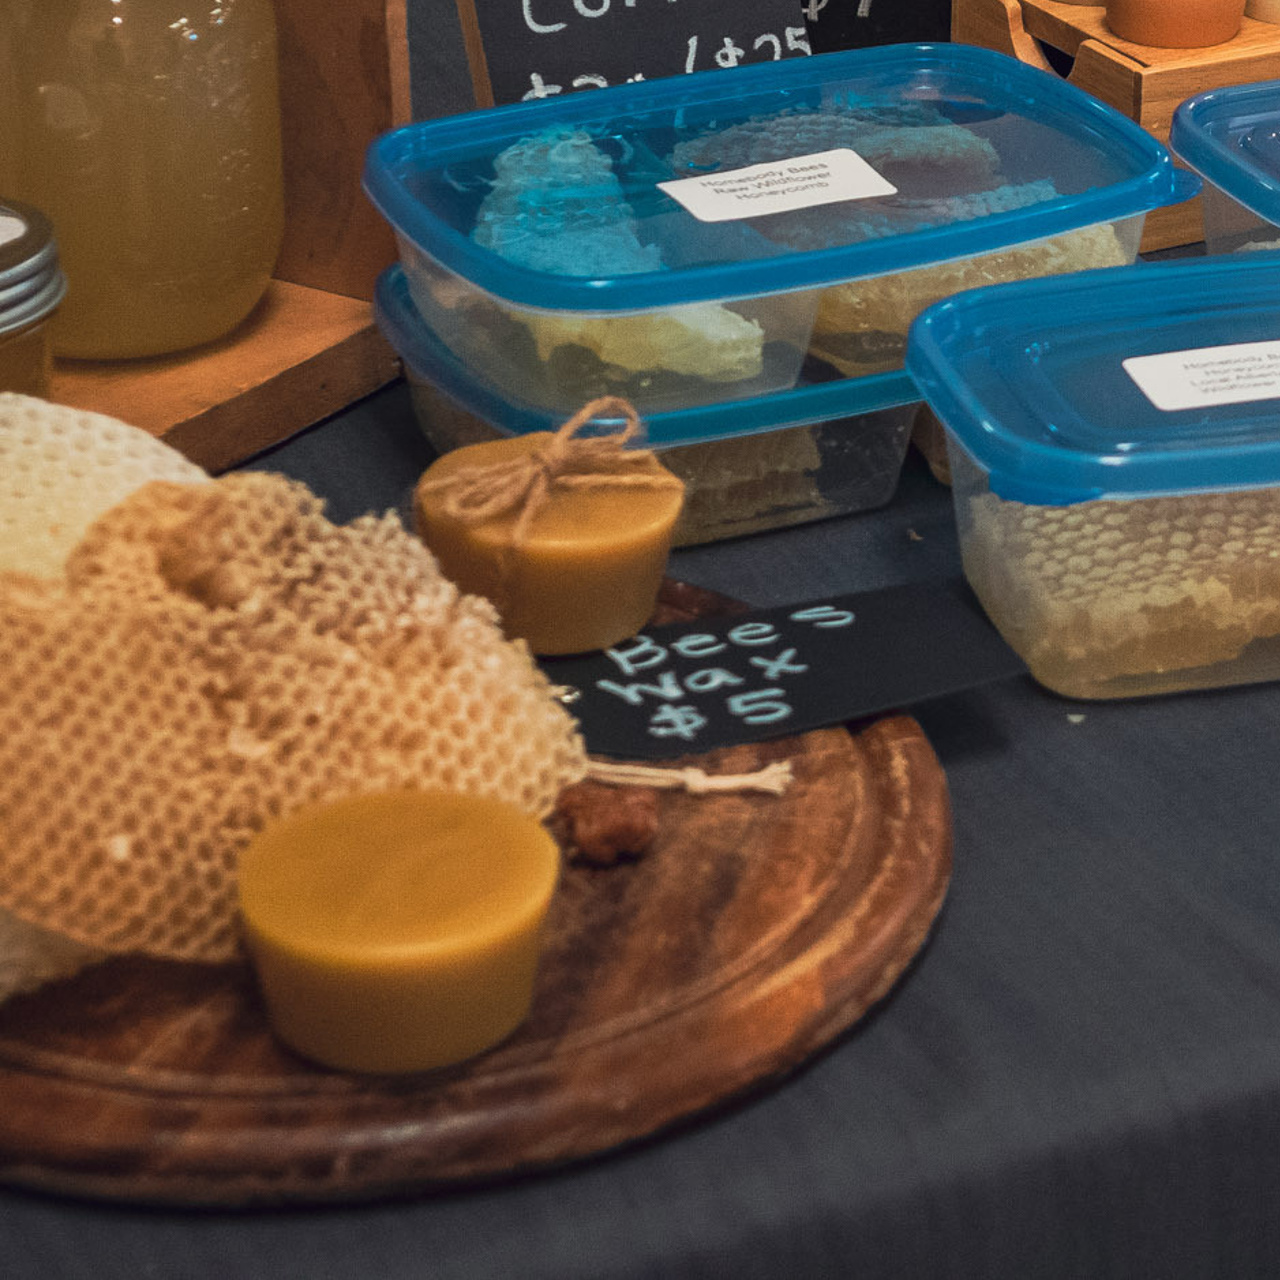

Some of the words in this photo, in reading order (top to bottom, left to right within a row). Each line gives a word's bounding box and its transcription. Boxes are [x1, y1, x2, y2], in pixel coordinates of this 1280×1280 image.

[786, 162, 829, 175] Bees
[734, 181, 830, 200] Honeycomb
[606, 605, 855, 675] Bees
[596, 647, 809, 705] Wax
